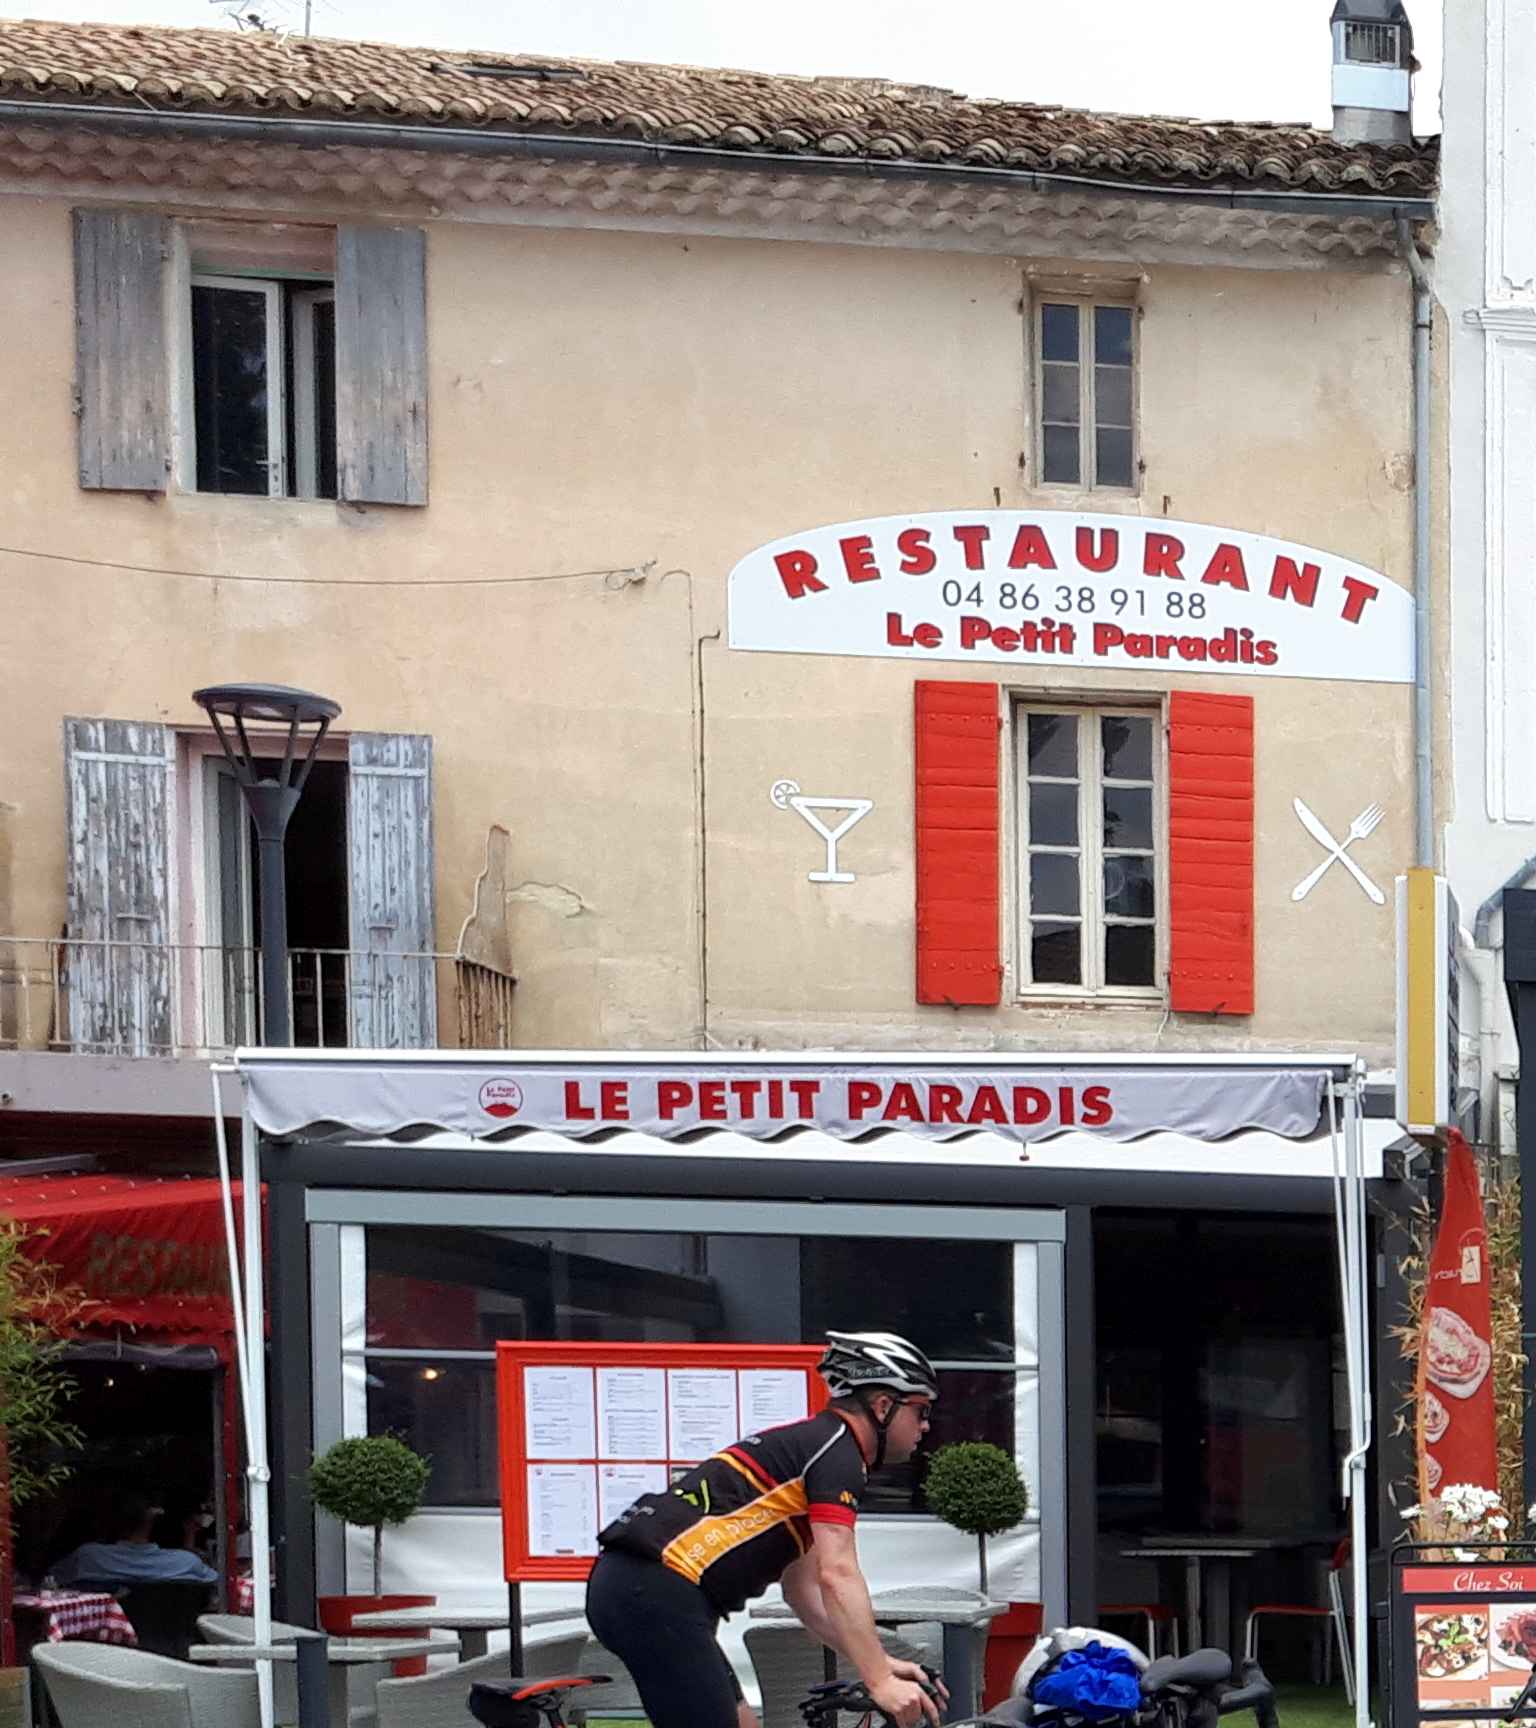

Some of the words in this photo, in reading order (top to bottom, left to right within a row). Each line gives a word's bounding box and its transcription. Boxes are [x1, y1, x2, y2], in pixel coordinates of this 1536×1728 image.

[774, 524, 1379, 624] RESTAURANT
[942, 580, 984, 607] 04
[998, 583, 1040, 612] 86
[1053, 584, 1096, 614] 38
[1109, 587, 1147, 617] 91
[1165, 591, 1207, 620] 88
[886, 611, 943, 648] Le
[959, 615, 1077, 656] Petit
[1092, 620, 1279, 667] Paradis
[563, 1080, 630, 1120] LE
[657, 1079, 822, 1120] PETIT
[846, 1080, 1115, 1126] PARADIS
[1453, 1571, 1491, 1592] Chez
[1495, 1572, 1524, 1592] Soi
